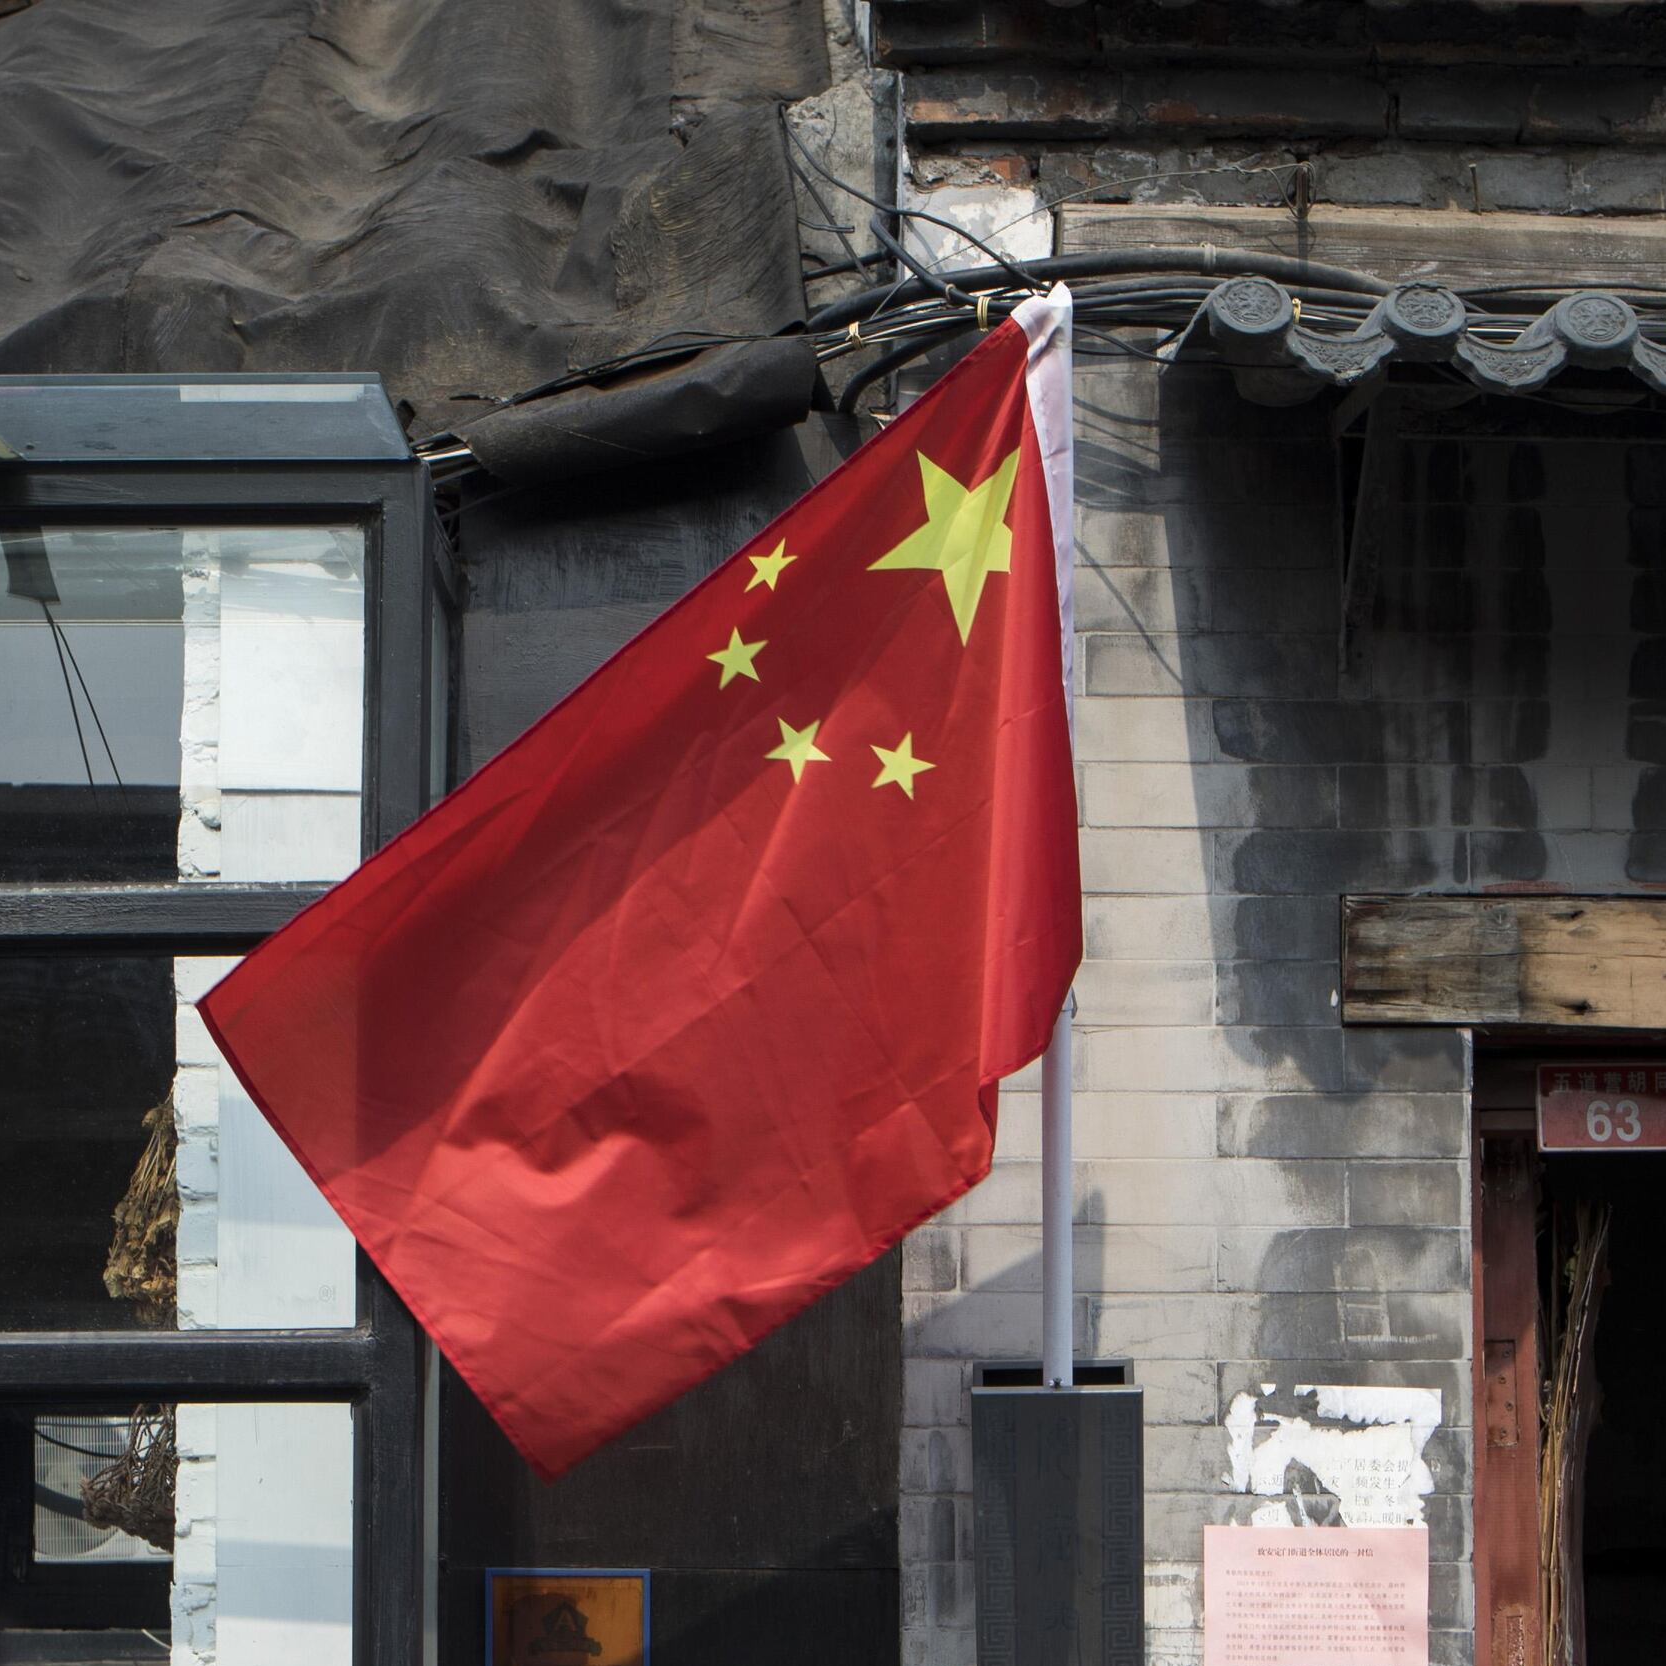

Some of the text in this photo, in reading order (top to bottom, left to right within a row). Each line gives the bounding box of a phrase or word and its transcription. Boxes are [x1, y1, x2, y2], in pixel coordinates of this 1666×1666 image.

[1586, 1099, 1642, 1142] 63
[1257, 1546, 1374, 1557] 致安定门街道全体居民的一封信
